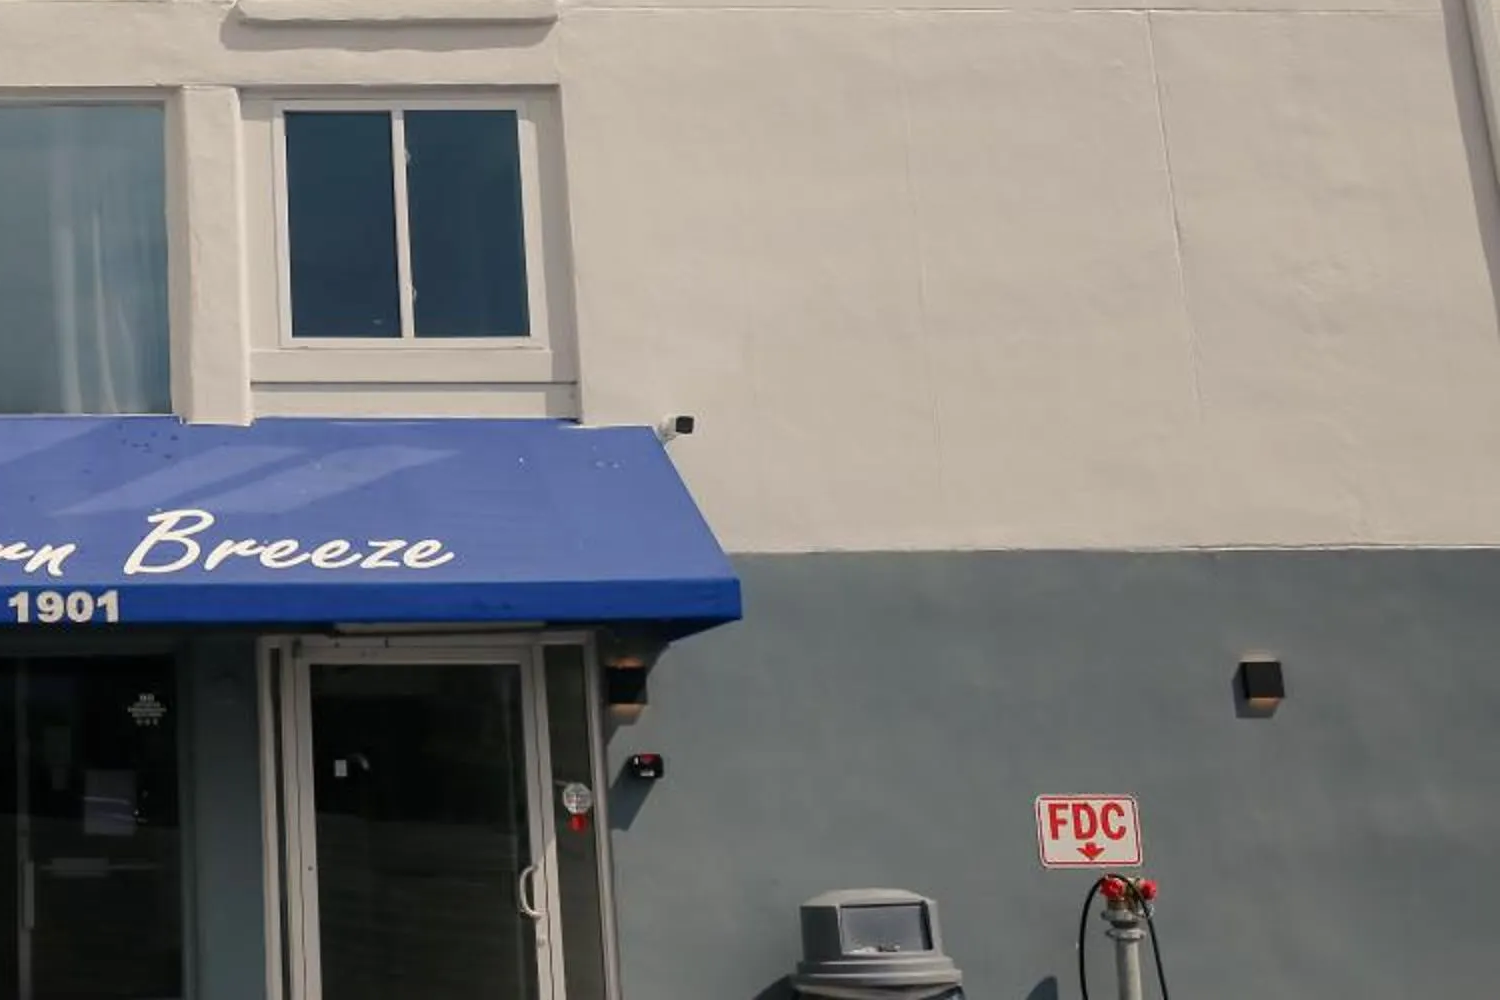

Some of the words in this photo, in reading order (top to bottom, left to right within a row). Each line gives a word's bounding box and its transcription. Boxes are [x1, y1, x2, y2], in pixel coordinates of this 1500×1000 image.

[124, 510, 455, 575] Breeze
[8, 590, 119, 623] 1901
[1048, 802, 1127, 841] FDC
